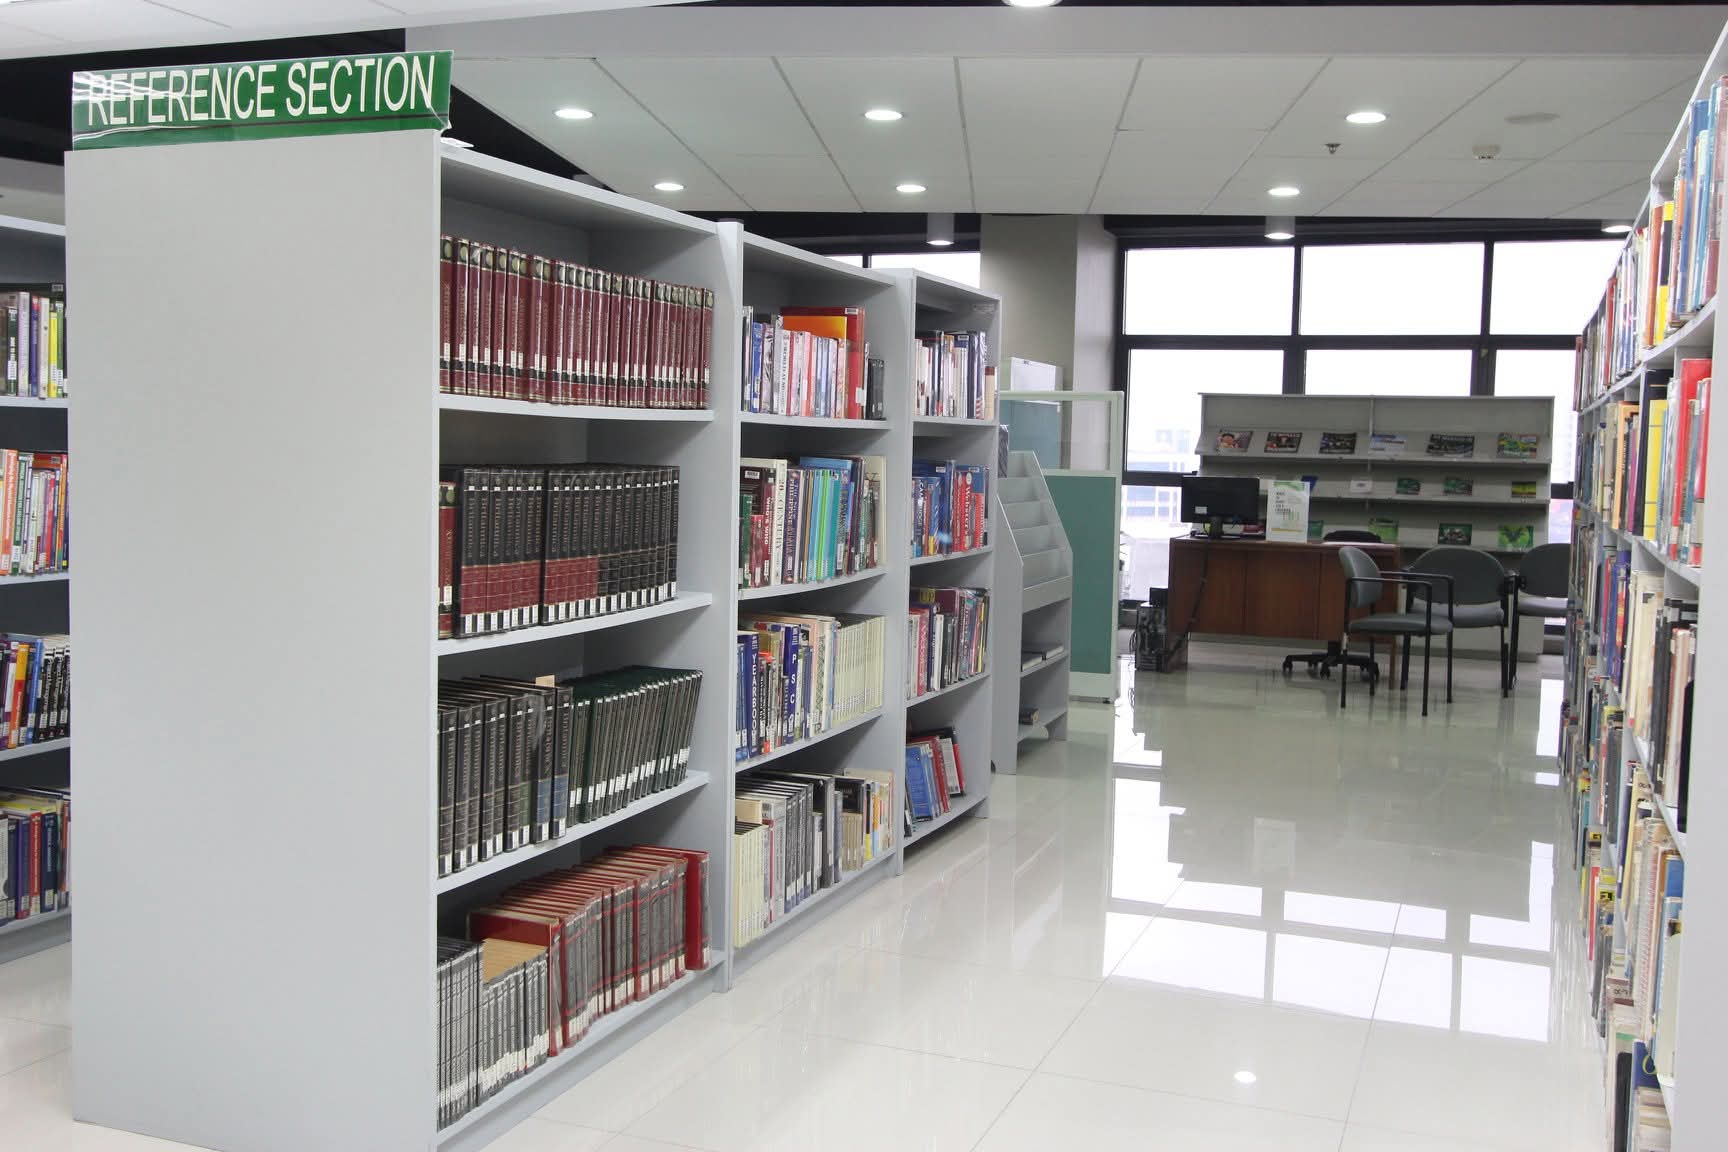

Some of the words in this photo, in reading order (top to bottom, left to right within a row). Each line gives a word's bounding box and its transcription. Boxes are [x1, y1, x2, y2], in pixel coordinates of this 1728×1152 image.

[88, 64, 277, 126] REFERENCE
[286, 55, 436, 117] SECTION
[964, 486, 972, 536] Webster's
